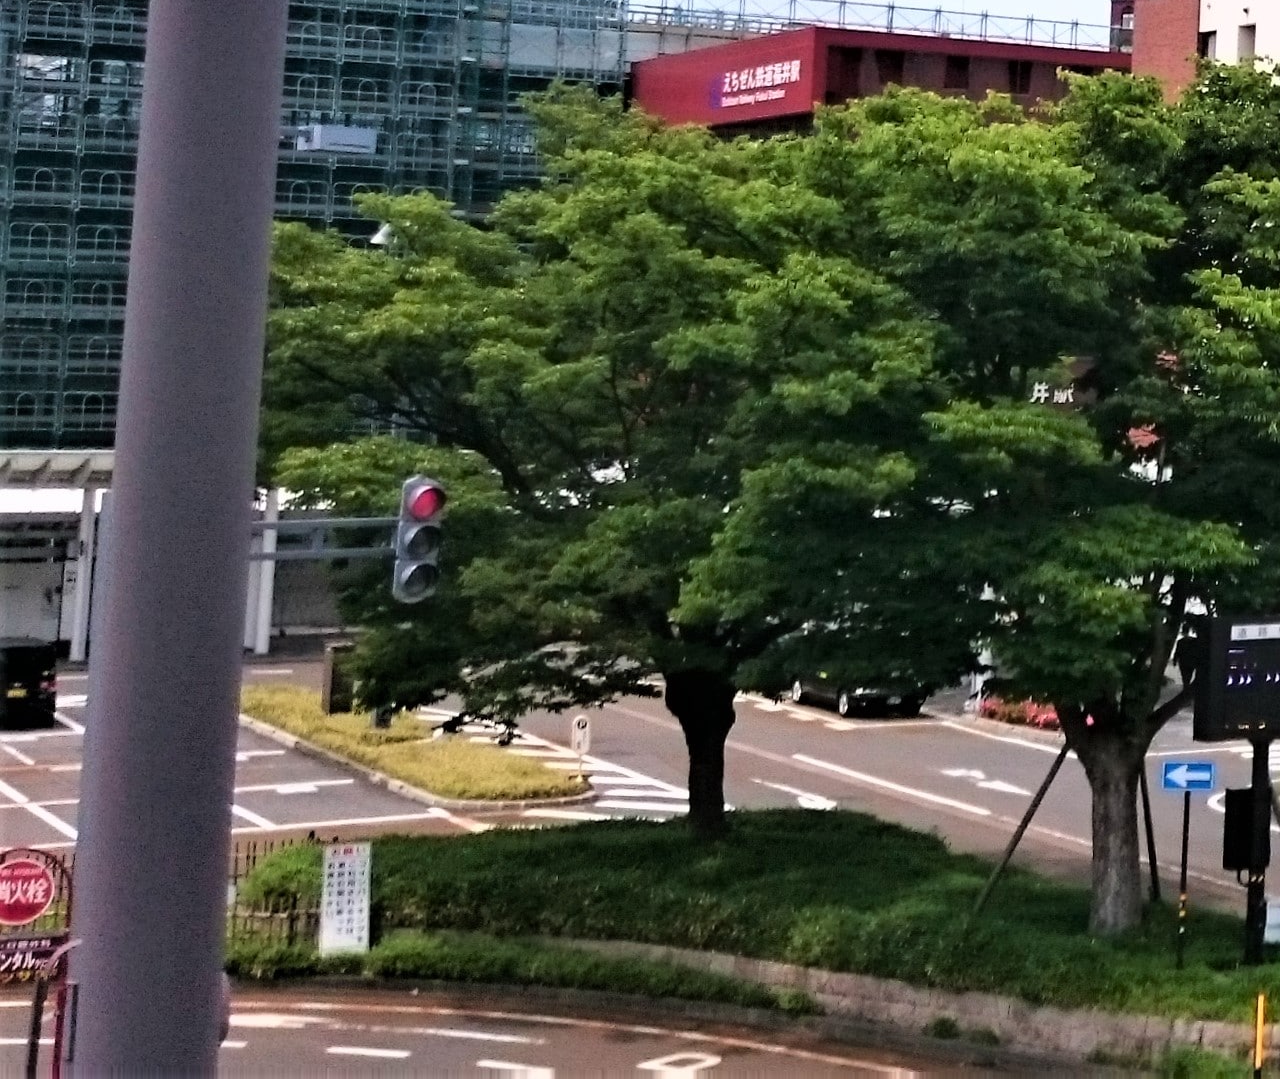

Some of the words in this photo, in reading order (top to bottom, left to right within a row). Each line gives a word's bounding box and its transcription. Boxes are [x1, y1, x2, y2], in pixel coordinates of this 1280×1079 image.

[723, 60, 801, 93] えちぜん鉄道福井駅
